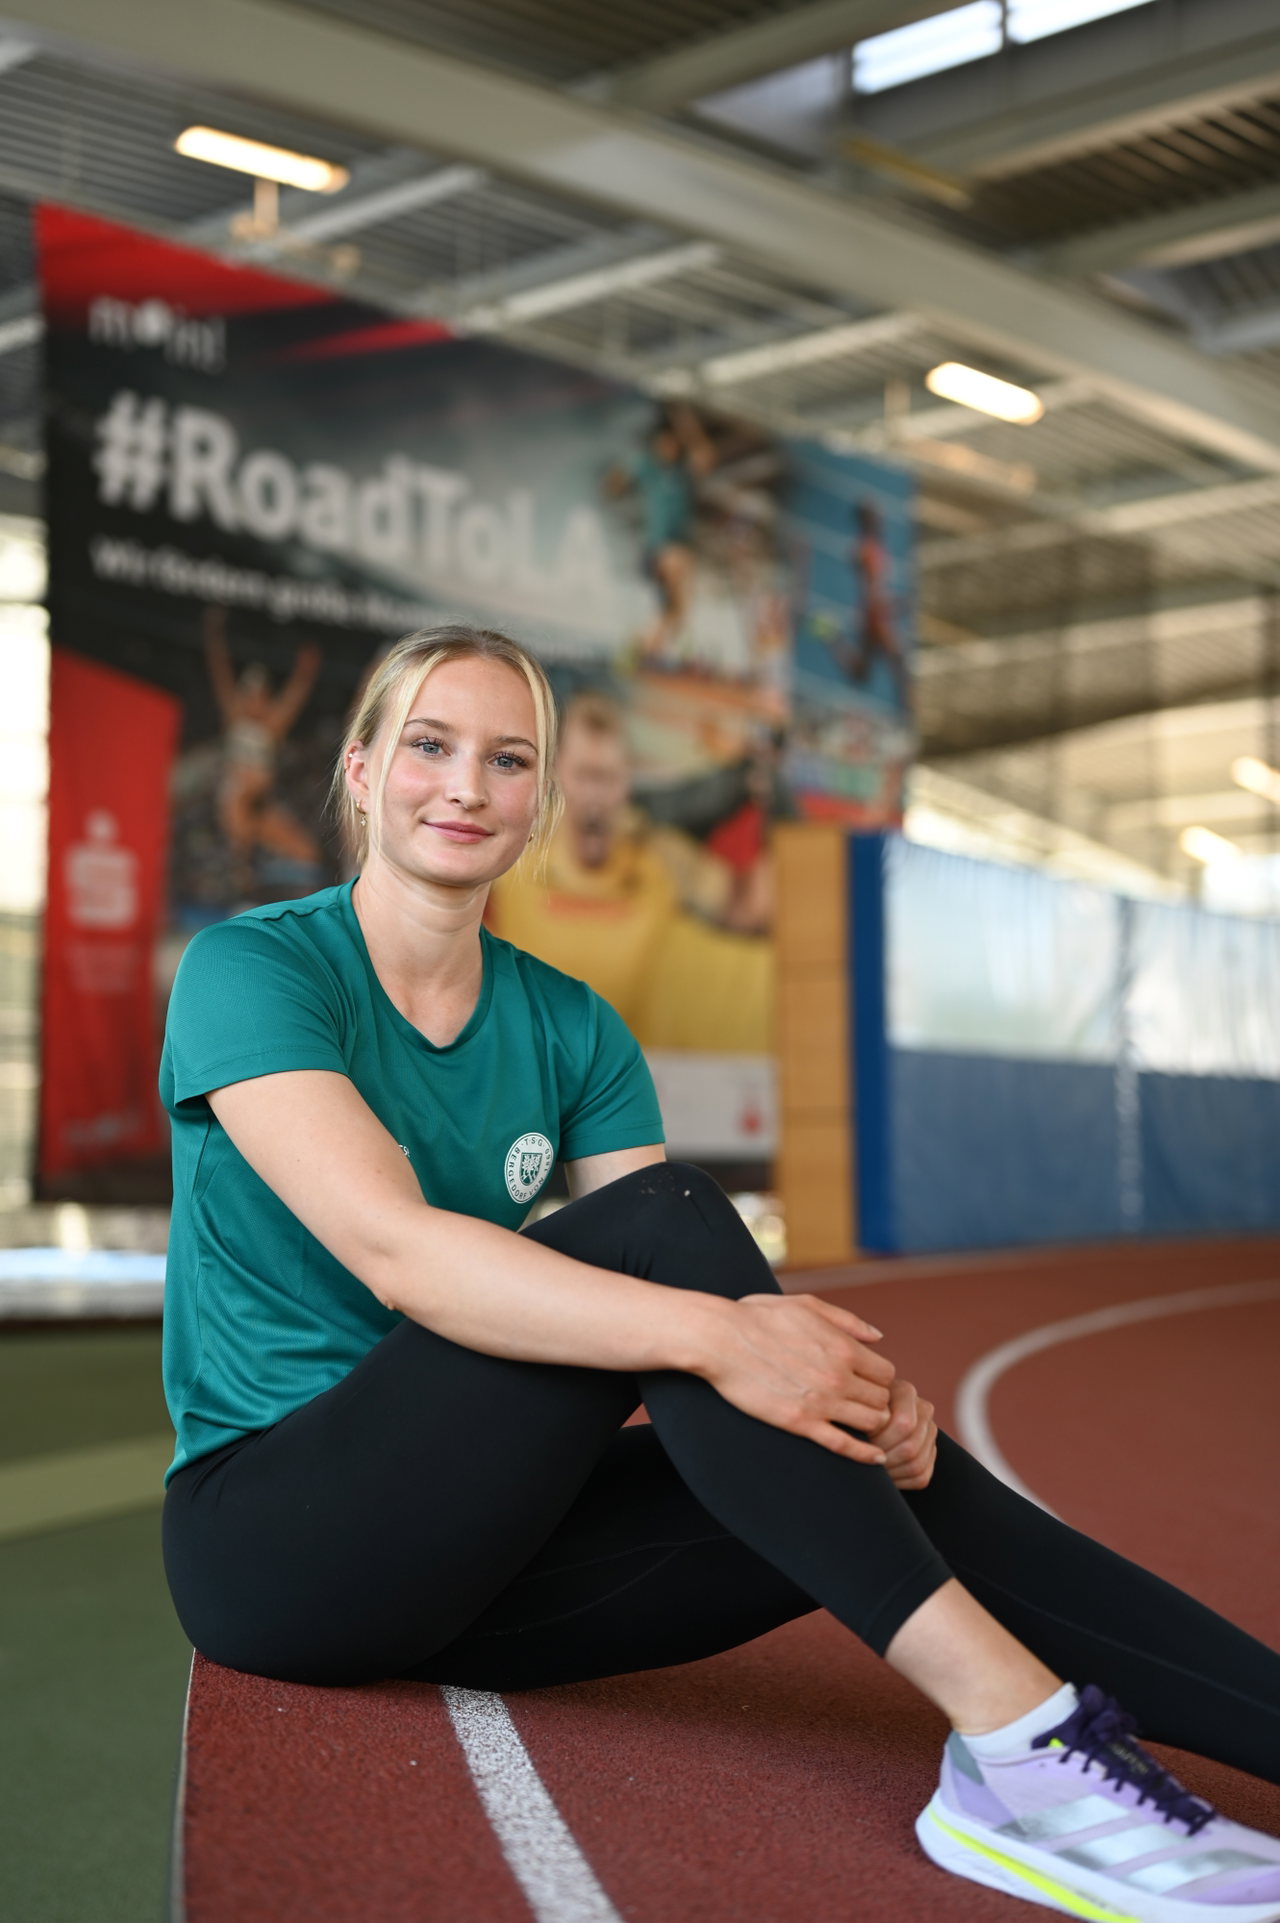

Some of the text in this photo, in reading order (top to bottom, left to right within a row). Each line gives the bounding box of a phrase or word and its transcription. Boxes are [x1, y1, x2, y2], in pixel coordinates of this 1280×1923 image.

[95, 396, 613, 594] #RoadToLA
[524, 1137, 543, 1147] TSG
[508, 1147, 527, 1199] BERGEDORF
